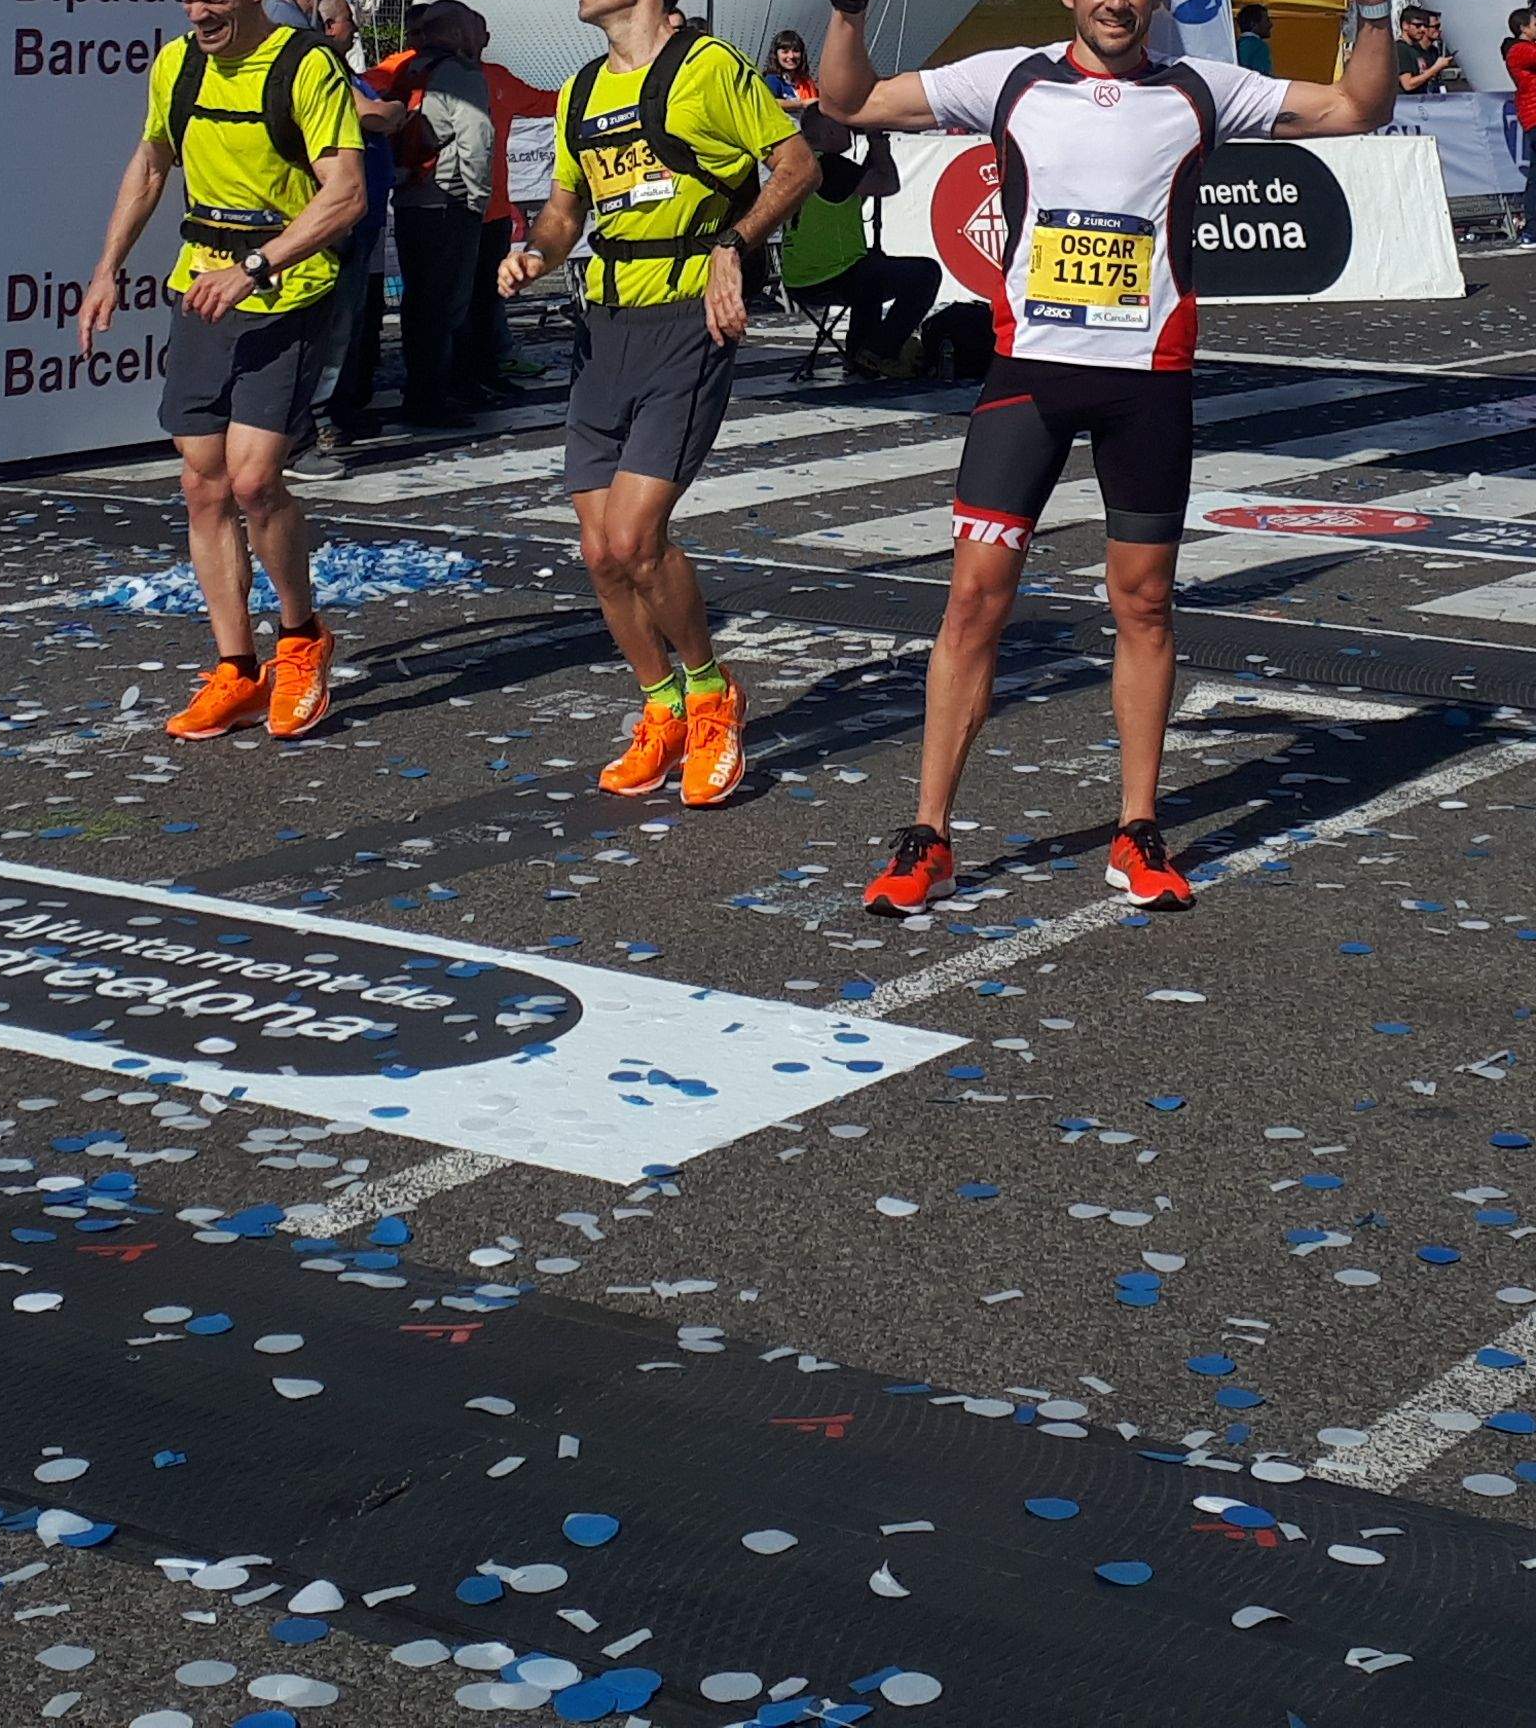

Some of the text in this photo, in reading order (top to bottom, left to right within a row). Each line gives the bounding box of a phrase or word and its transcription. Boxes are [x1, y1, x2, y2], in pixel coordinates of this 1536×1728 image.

[1265, 177, 1299, 204] de
[1083, 216, 1122, 229] ZURICH
[1192, 213, 1307, 251] elona
[1060, 234, 1136, 260] OSCAR
[1053, 258, 1138, 288] 11175
[6, 270, 174, 329] Dipta
[1042, 306, 1073, 319] asics
[361, 981, 457, 1012] de
